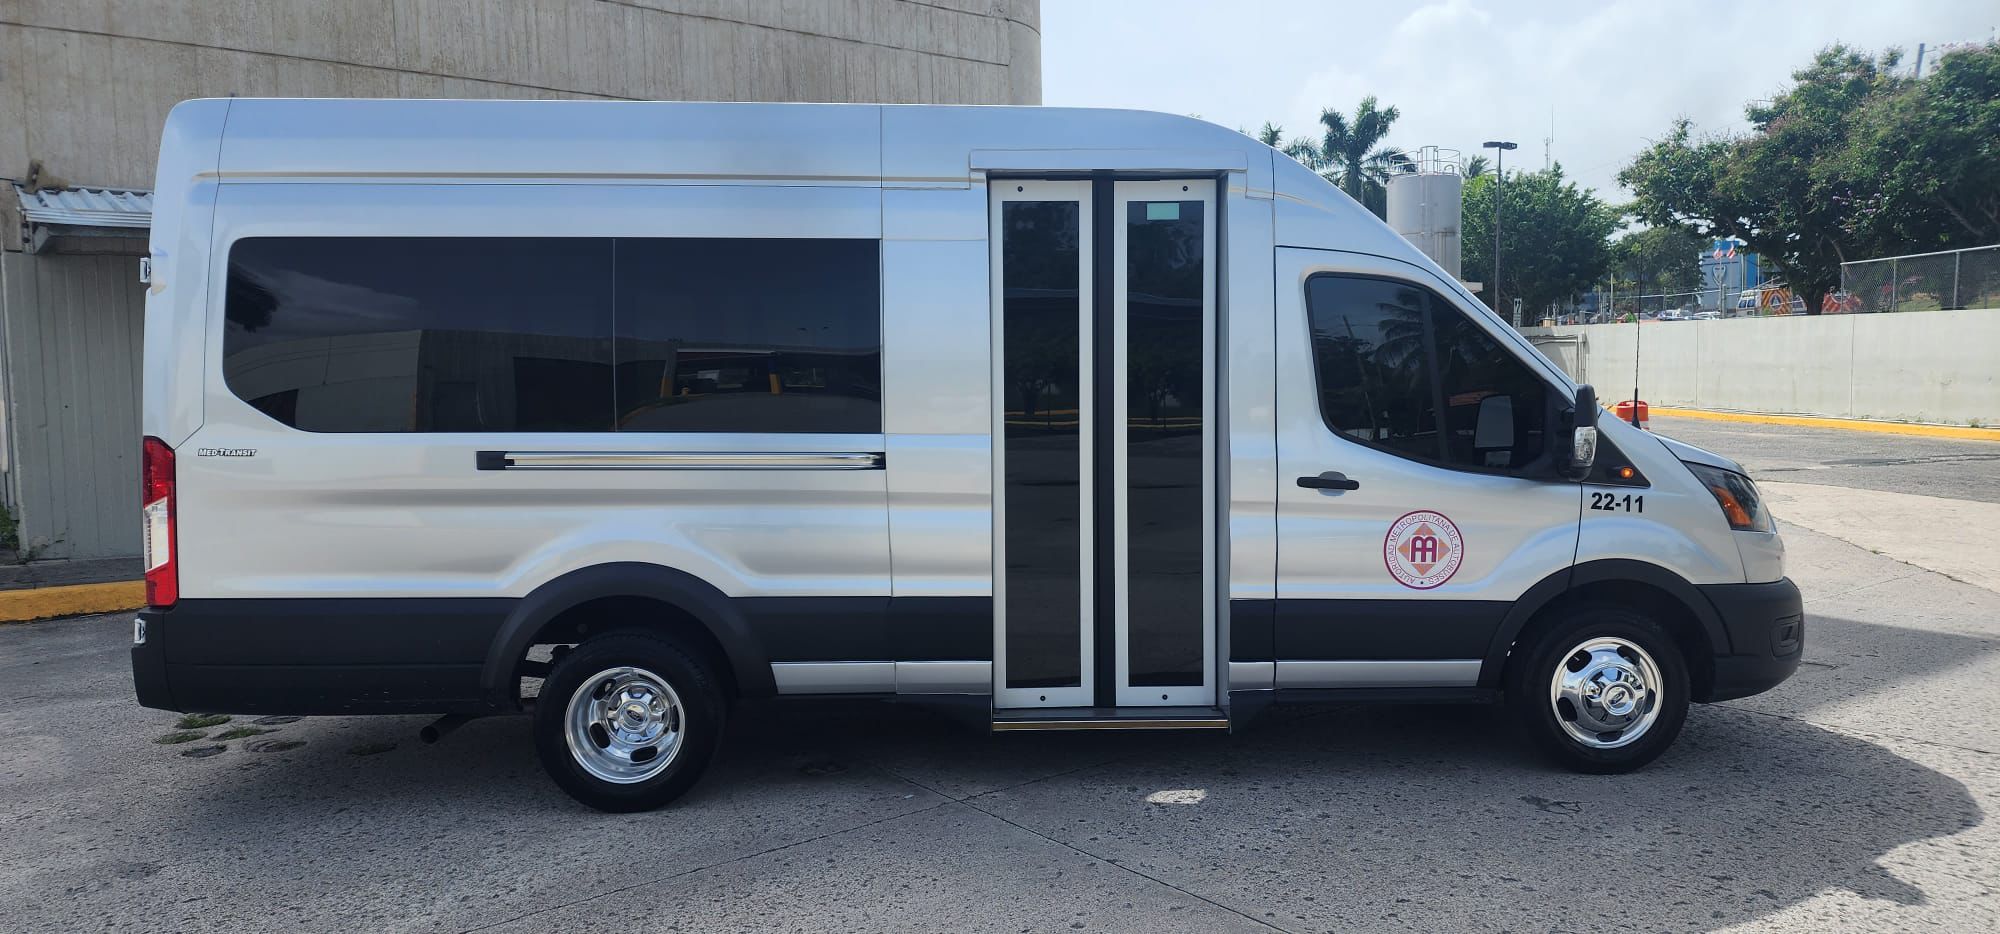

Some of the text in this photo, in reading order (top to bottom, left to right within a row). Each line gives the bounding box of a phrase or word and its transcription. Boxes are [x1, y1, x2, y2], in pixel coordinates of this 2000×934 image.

[1591, 492, 1643, 513] 22-11
[1387, 513, 1460, 585] AUTORIDAD METROPOLITANA DE AUTOBUSES
